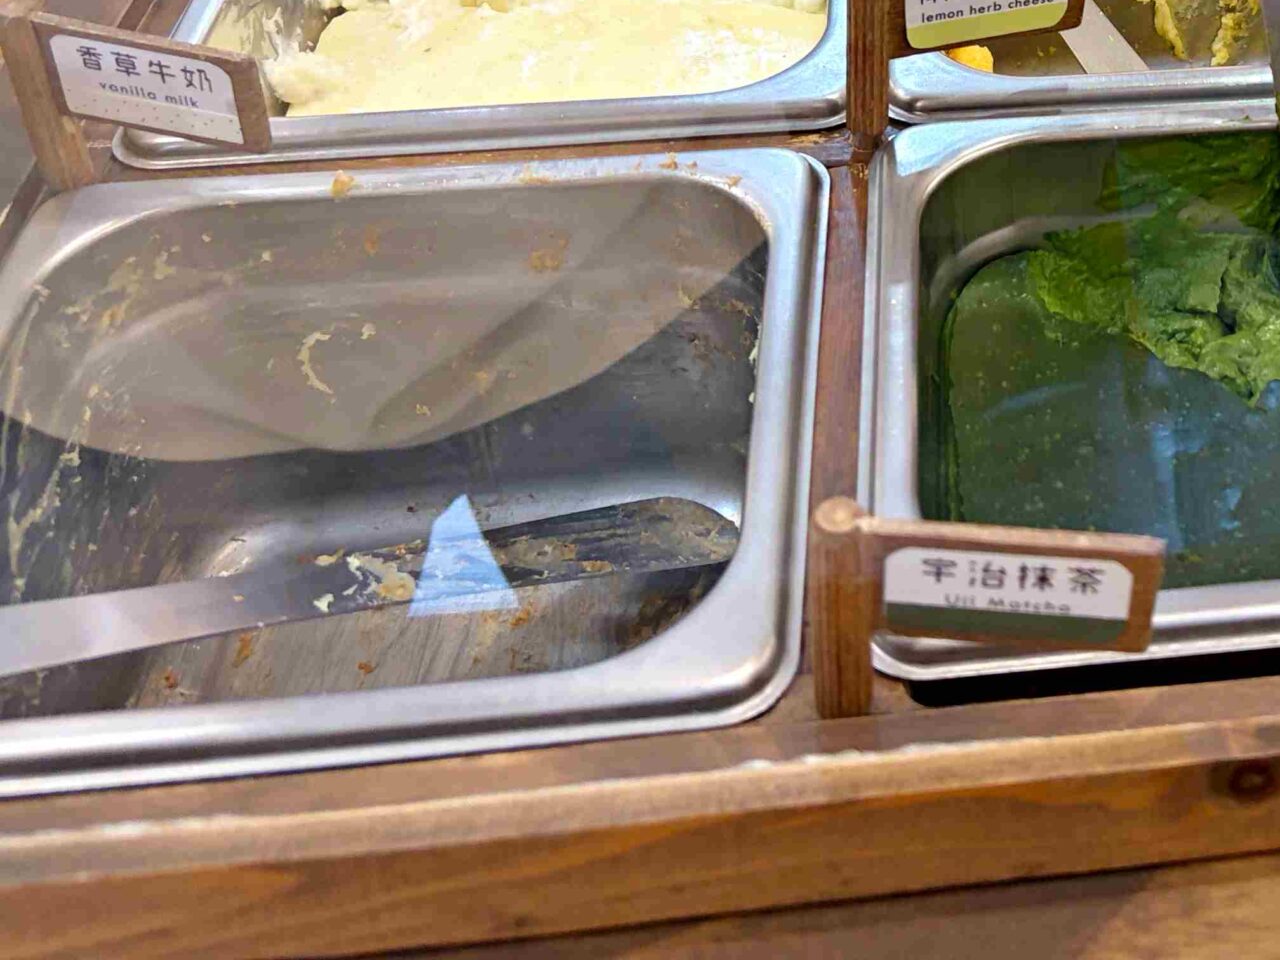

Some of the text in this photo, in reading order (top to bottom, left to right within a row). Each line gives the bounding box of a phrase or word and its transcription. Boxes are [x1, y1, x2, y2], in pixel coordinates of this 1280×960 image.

[922, 9, 964, 24] lemon
[969, 2, 1002, 16] herb
[76, 44, 214, 94] 香草牛奶
[99, 80, 200, 109] vanilla milk
[921, 557, 1107, 596] 宇治抹茶
